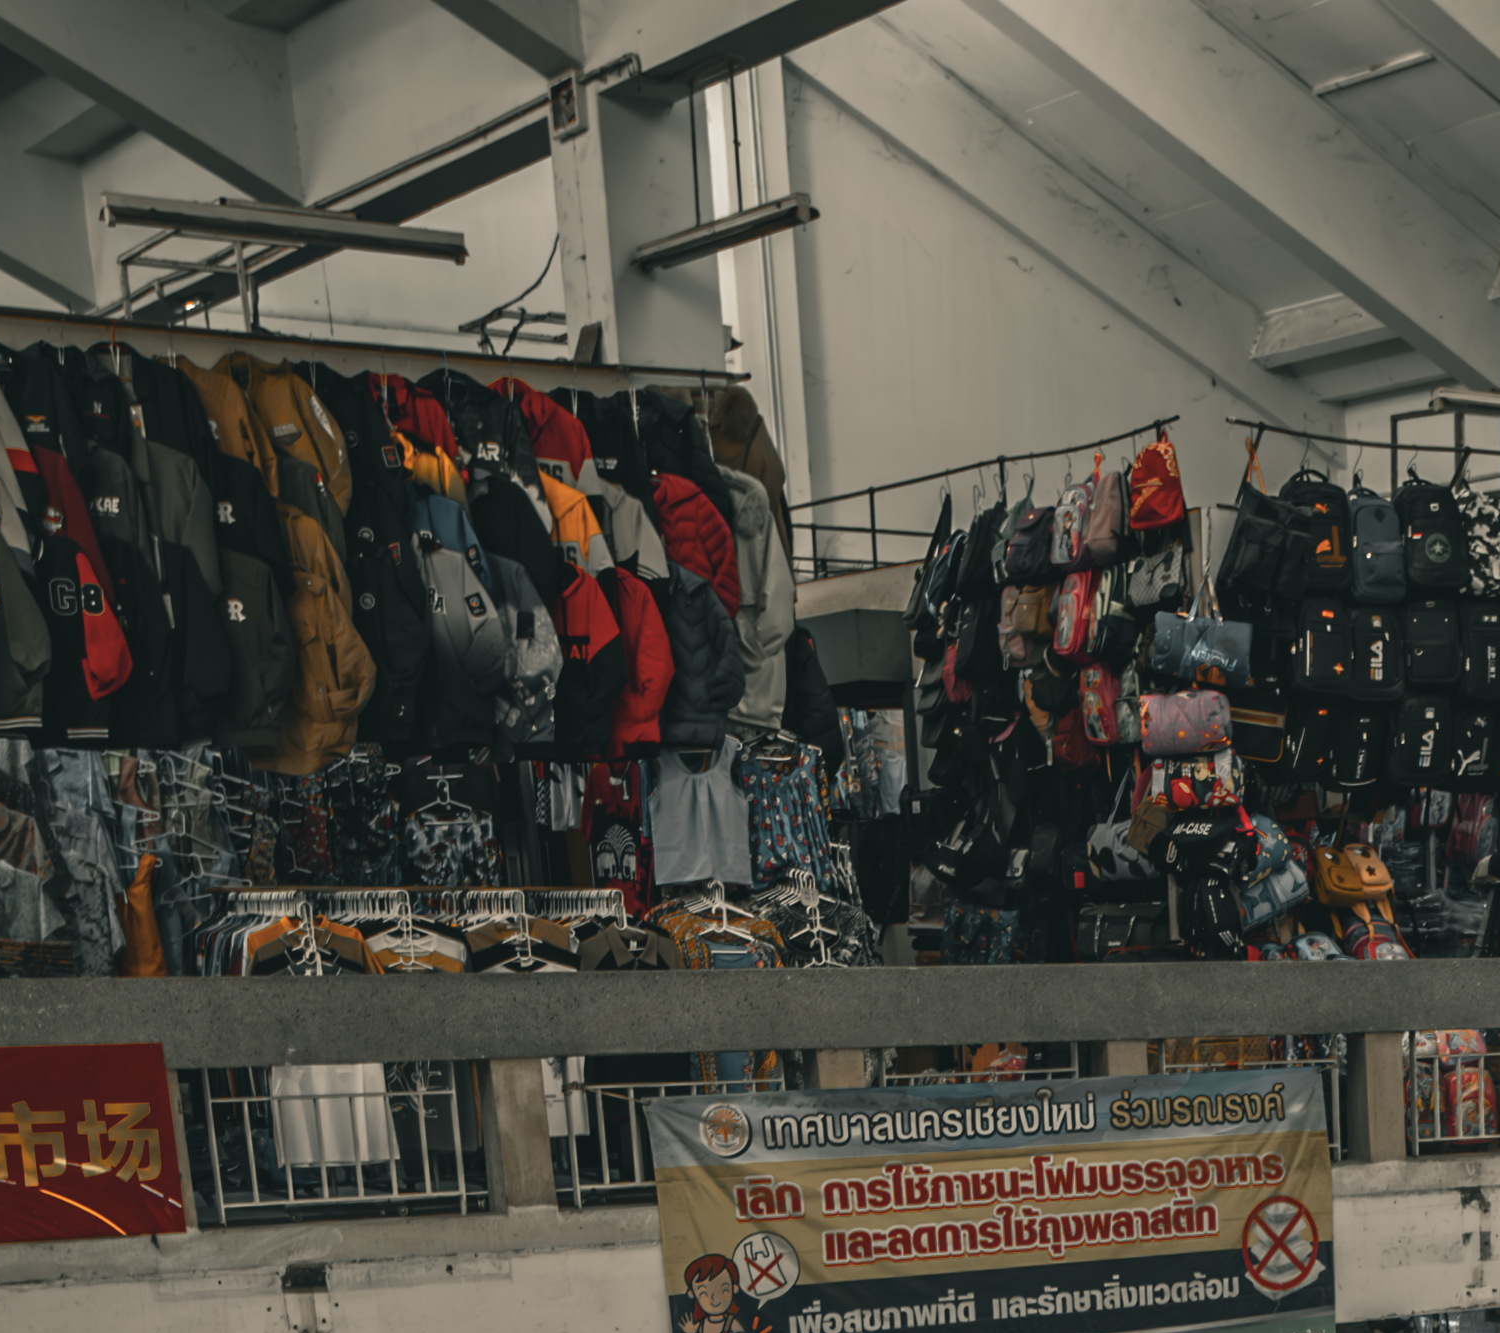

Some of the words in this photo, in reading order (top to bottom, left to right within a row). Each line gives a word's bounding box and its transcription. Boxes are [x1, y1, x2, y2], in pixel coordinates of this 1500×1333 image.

[217, 501, 237, 524] R
[226, 597, 247, 622] R
[763, 1090, 1096, 1149] เทศบาลนครเชียงใหม่
[1110, 1083, 1285, 1129] ร่วมรณรงค์
[735, 1176, 803, 1219] เลิก
[822, 1153, 1285, 1215] การใช้ภาชนะโฟมบรรจุอาหาร
[823, 1198, 1218, 1265] และลดการใช้ถุงพลาสติก
[991, 1271, 1240, 1320] และรักษาสิ่งแวดล้อม
